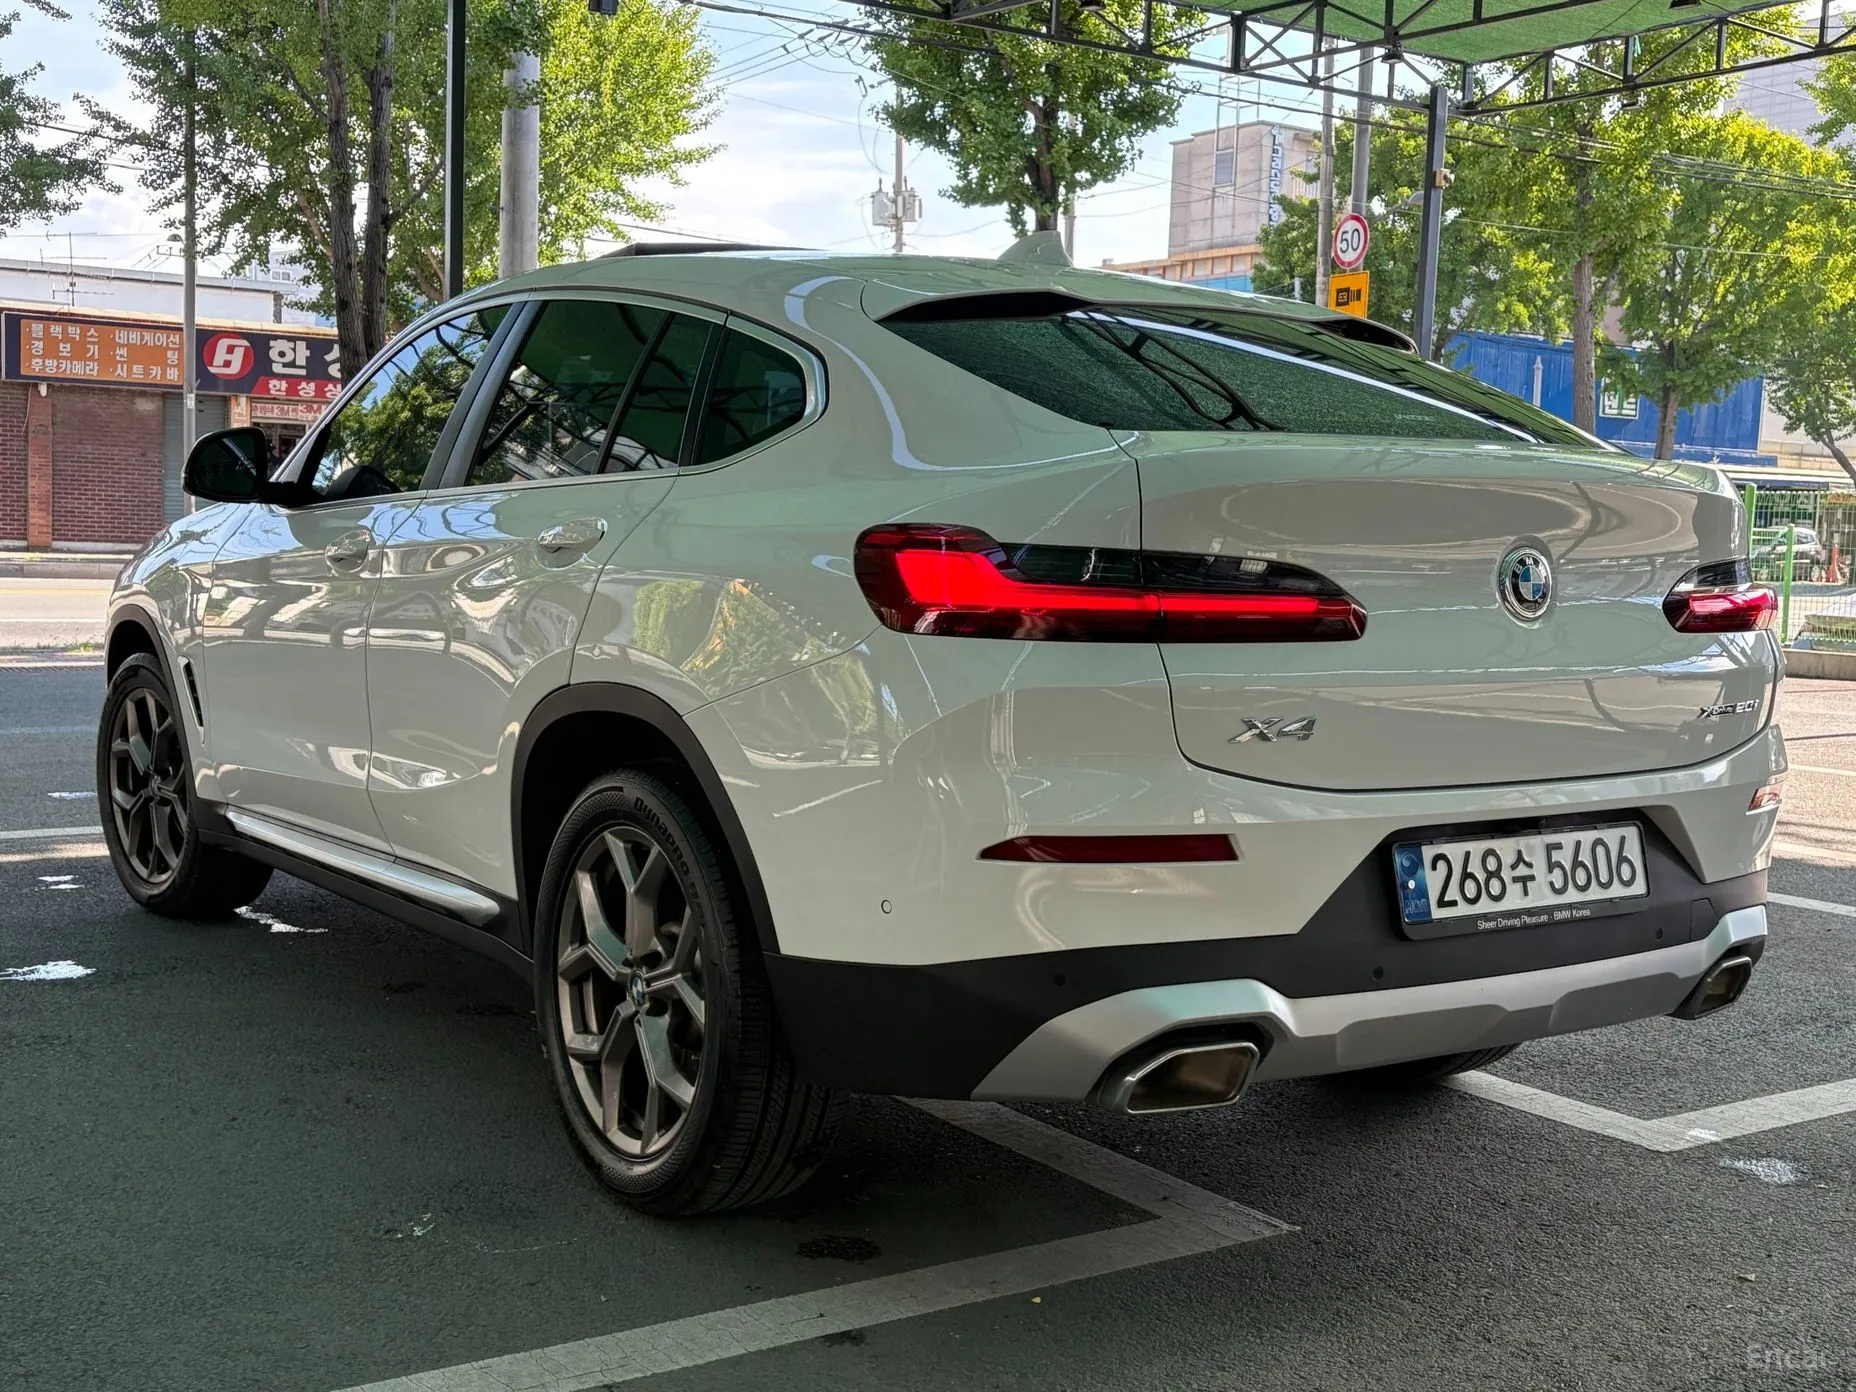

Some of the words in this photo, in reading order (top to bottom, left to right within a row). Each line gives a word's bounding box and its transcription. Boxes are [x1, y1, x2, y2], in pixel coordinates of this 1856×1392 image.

[1340, 228, 1361, 253] 50
[31, 323, 99, 342] 블랙박스
[115, 329, 180, 348] 네비게이션
[31, 340, 99, 360] 경보기
[31, 357, 99, 377] 후방카메라
[114, 364, 180, 382] 시트카바
[276, 406, 290, 417] 3M
[300, 403, 322, 414] 3M
[1227, 715, 1317, 744] X4
[1477, 919, 1497, 930] Sheer
[1498, 917, 1521, 928] Driving
[1521, 914, 1549, 925] Pleasure
[1553, 910, 1571, 921] BMW
[1572, 908, 1591, 918] Korea
